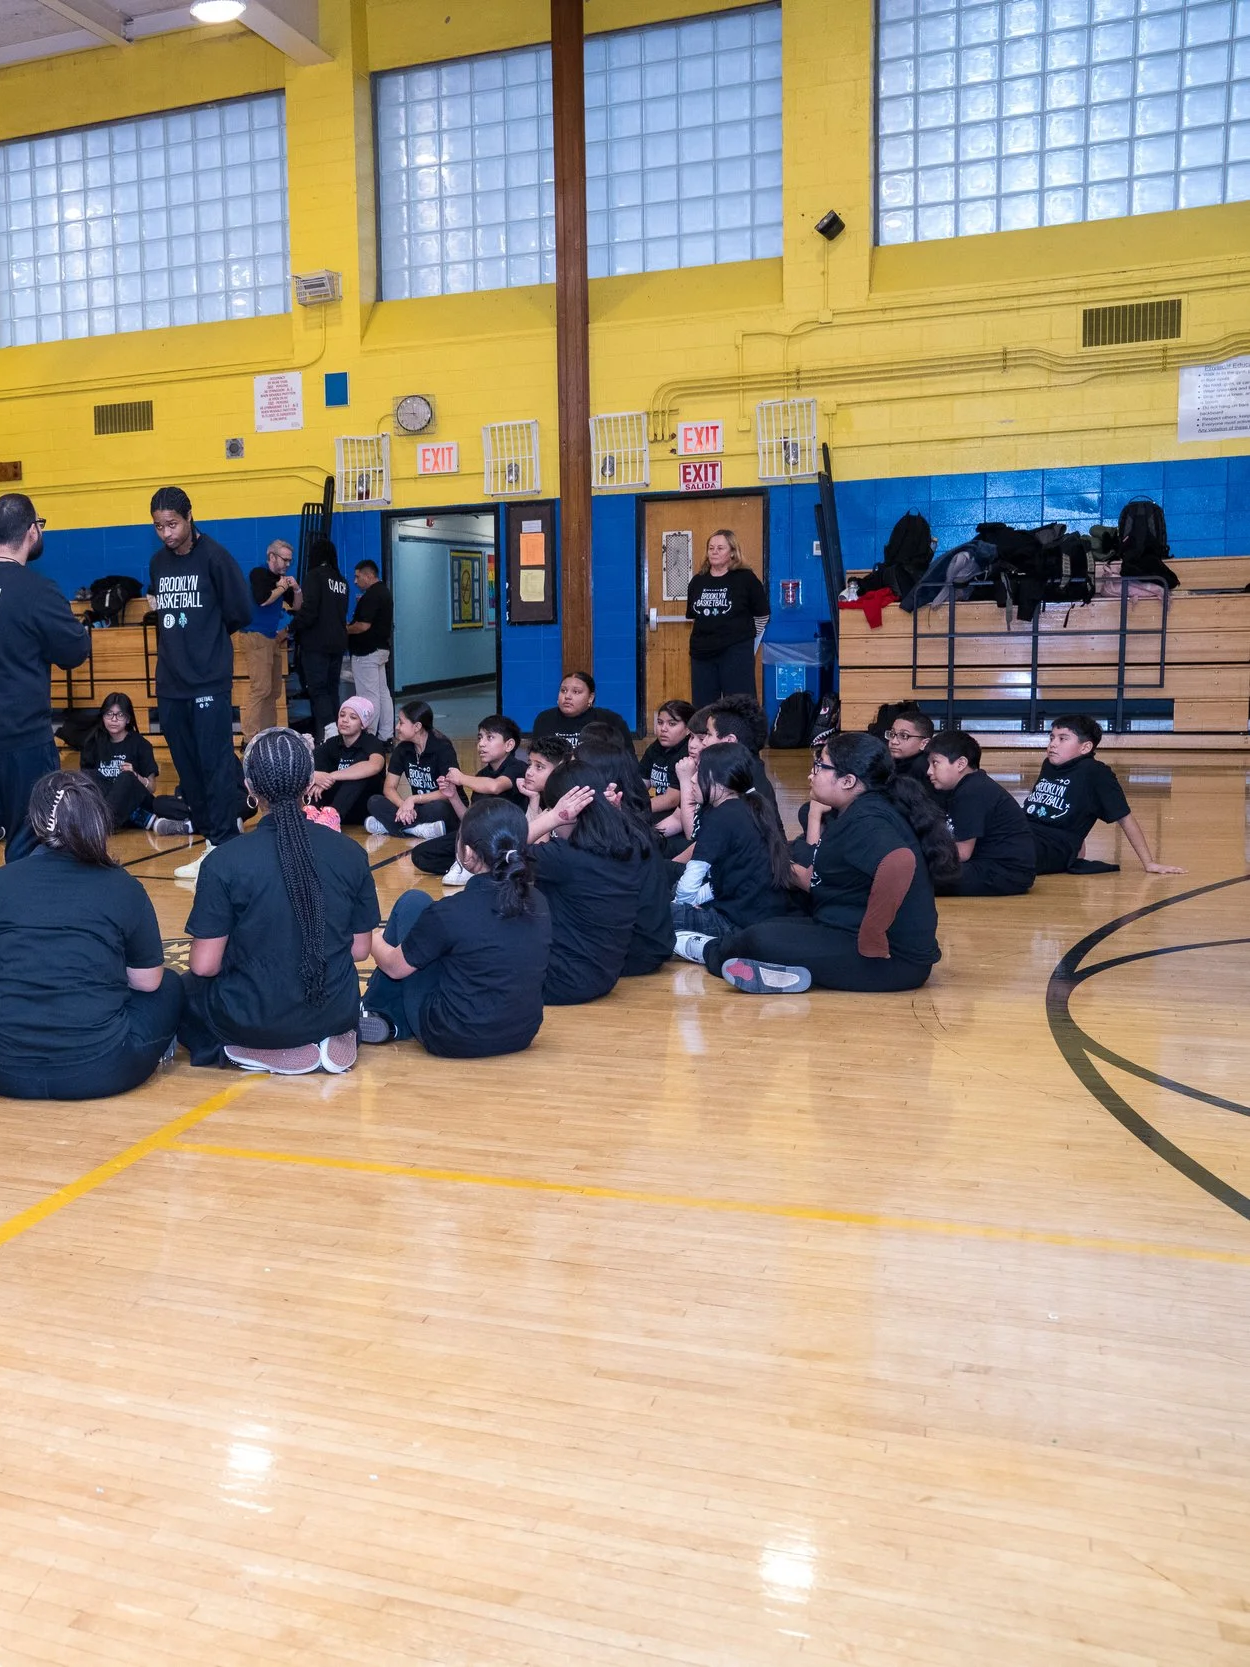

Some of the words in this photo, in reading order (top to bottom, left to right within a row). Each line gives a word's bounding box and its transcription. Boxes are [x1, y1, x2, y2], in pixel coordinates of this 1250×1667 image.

[684, 426, 719, 452] EXIT
[422, 446, 453, 472] EXIT
[682, 463, 719, 483] EXIT
[159, 575, 198, 593] BROOKLYN
[156, 592, 203, 610] BASKETBALL
[696, 599, 728, 607] BASKETBALL
[700, 592, 726, 600] BROOKLYN
